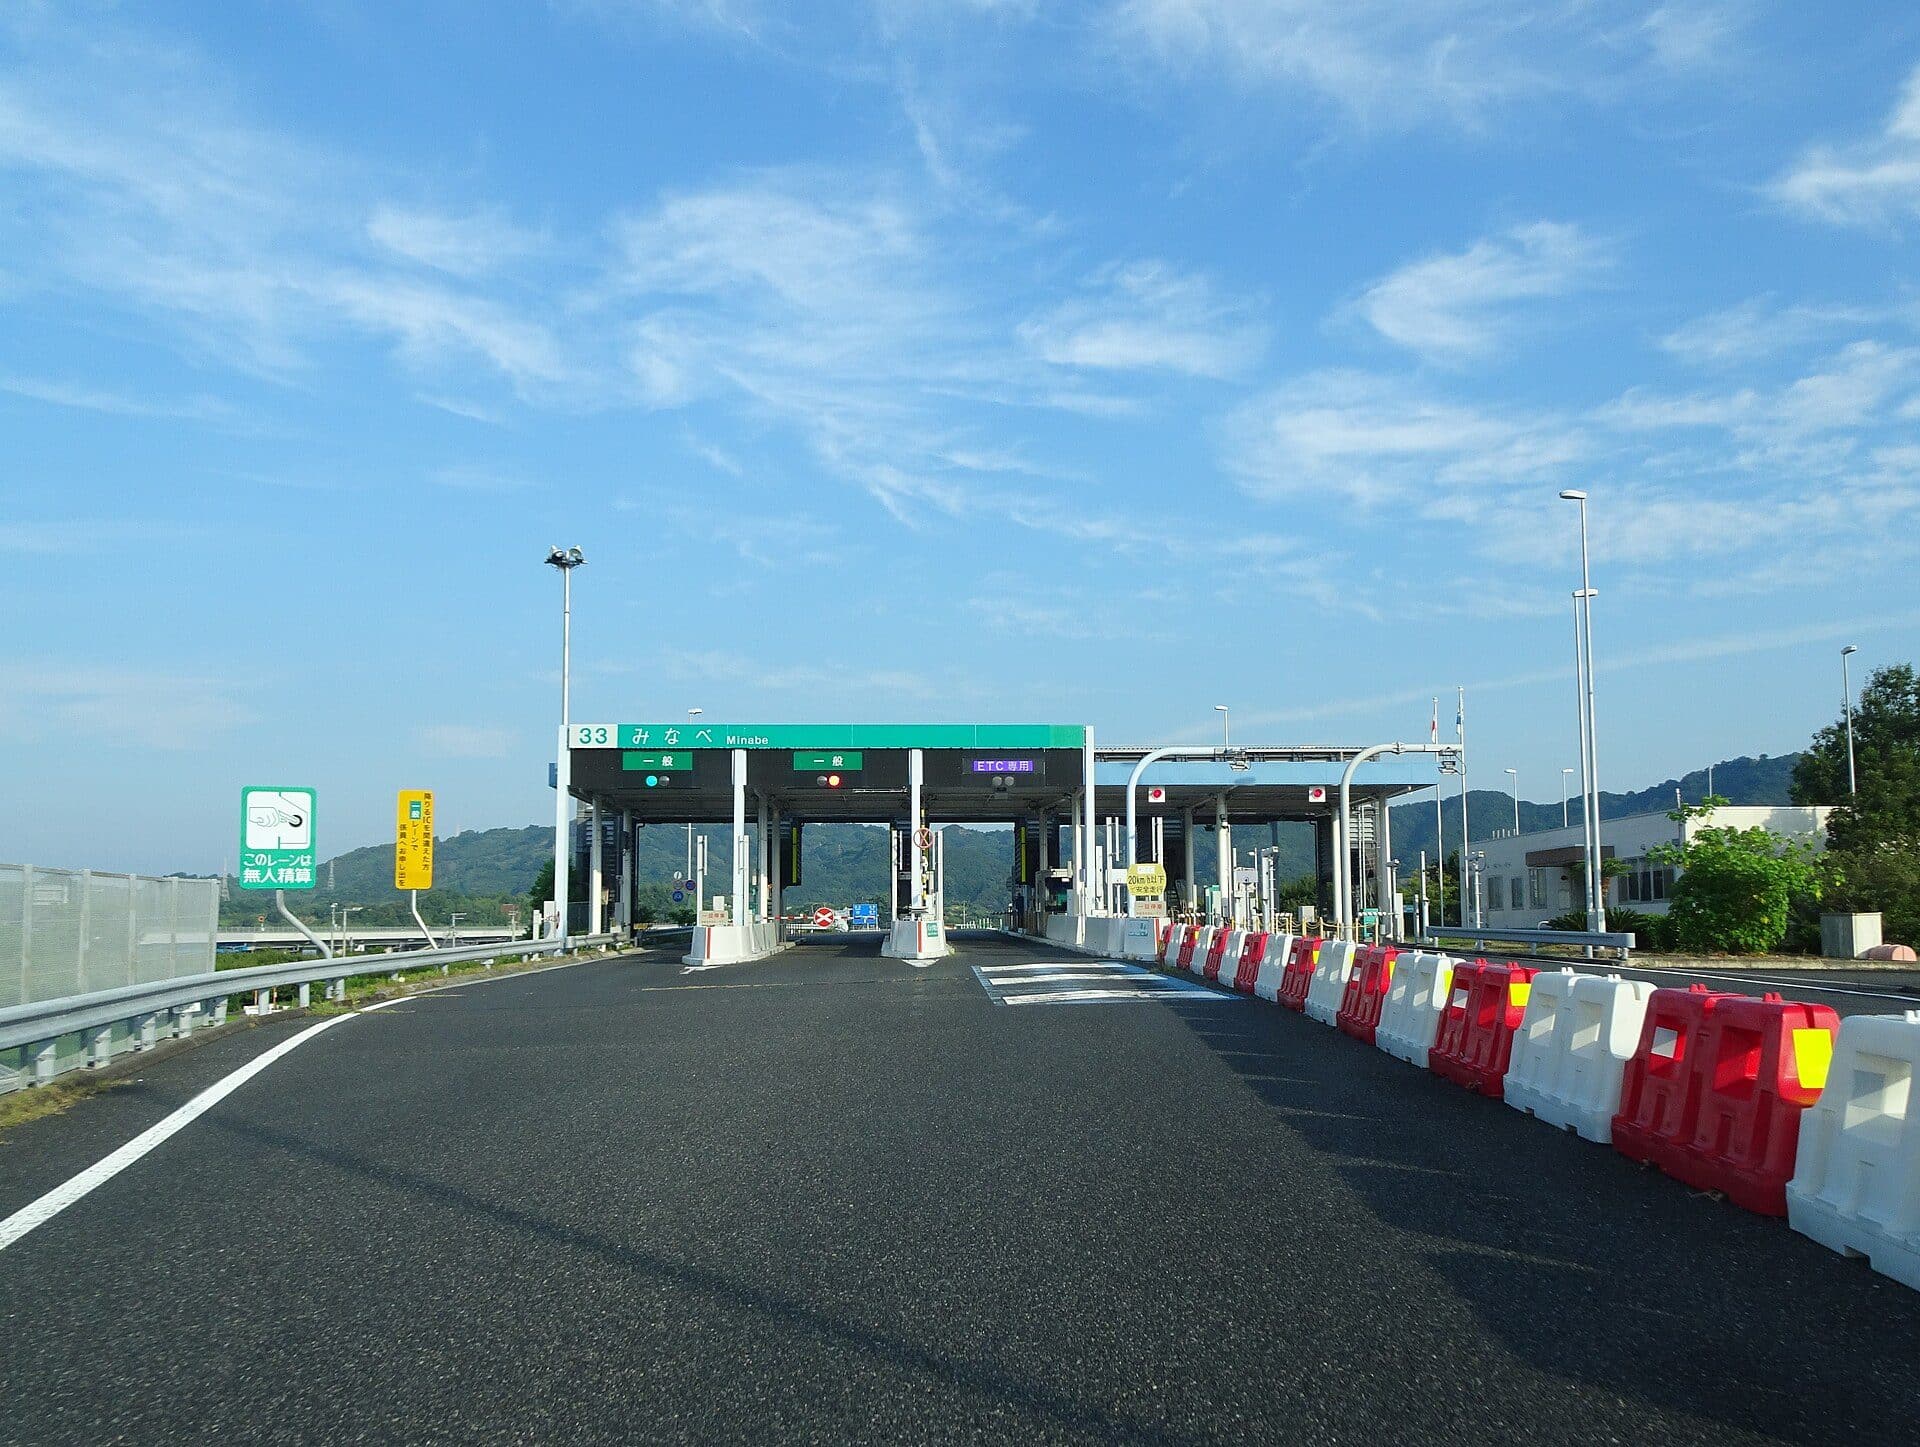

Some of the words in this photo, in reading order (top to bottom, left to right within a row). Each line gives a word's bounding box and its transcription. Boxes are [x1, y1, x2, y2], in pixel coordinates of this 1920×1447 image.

[579, 728, 608, 744] 33
[632, 728, 713, 745] みなべ
[726, 735, 769, 745] Minabe
[642, 755, 675, 767] 一般
[813, 755, 845, 767] 一般
[977, 760, 1004, 771] ETC
[1007, 760, 1030, 771] 専用
[243, 853, 312, 866] このレーンは
[242, 868, 313, 884] 無人精算
